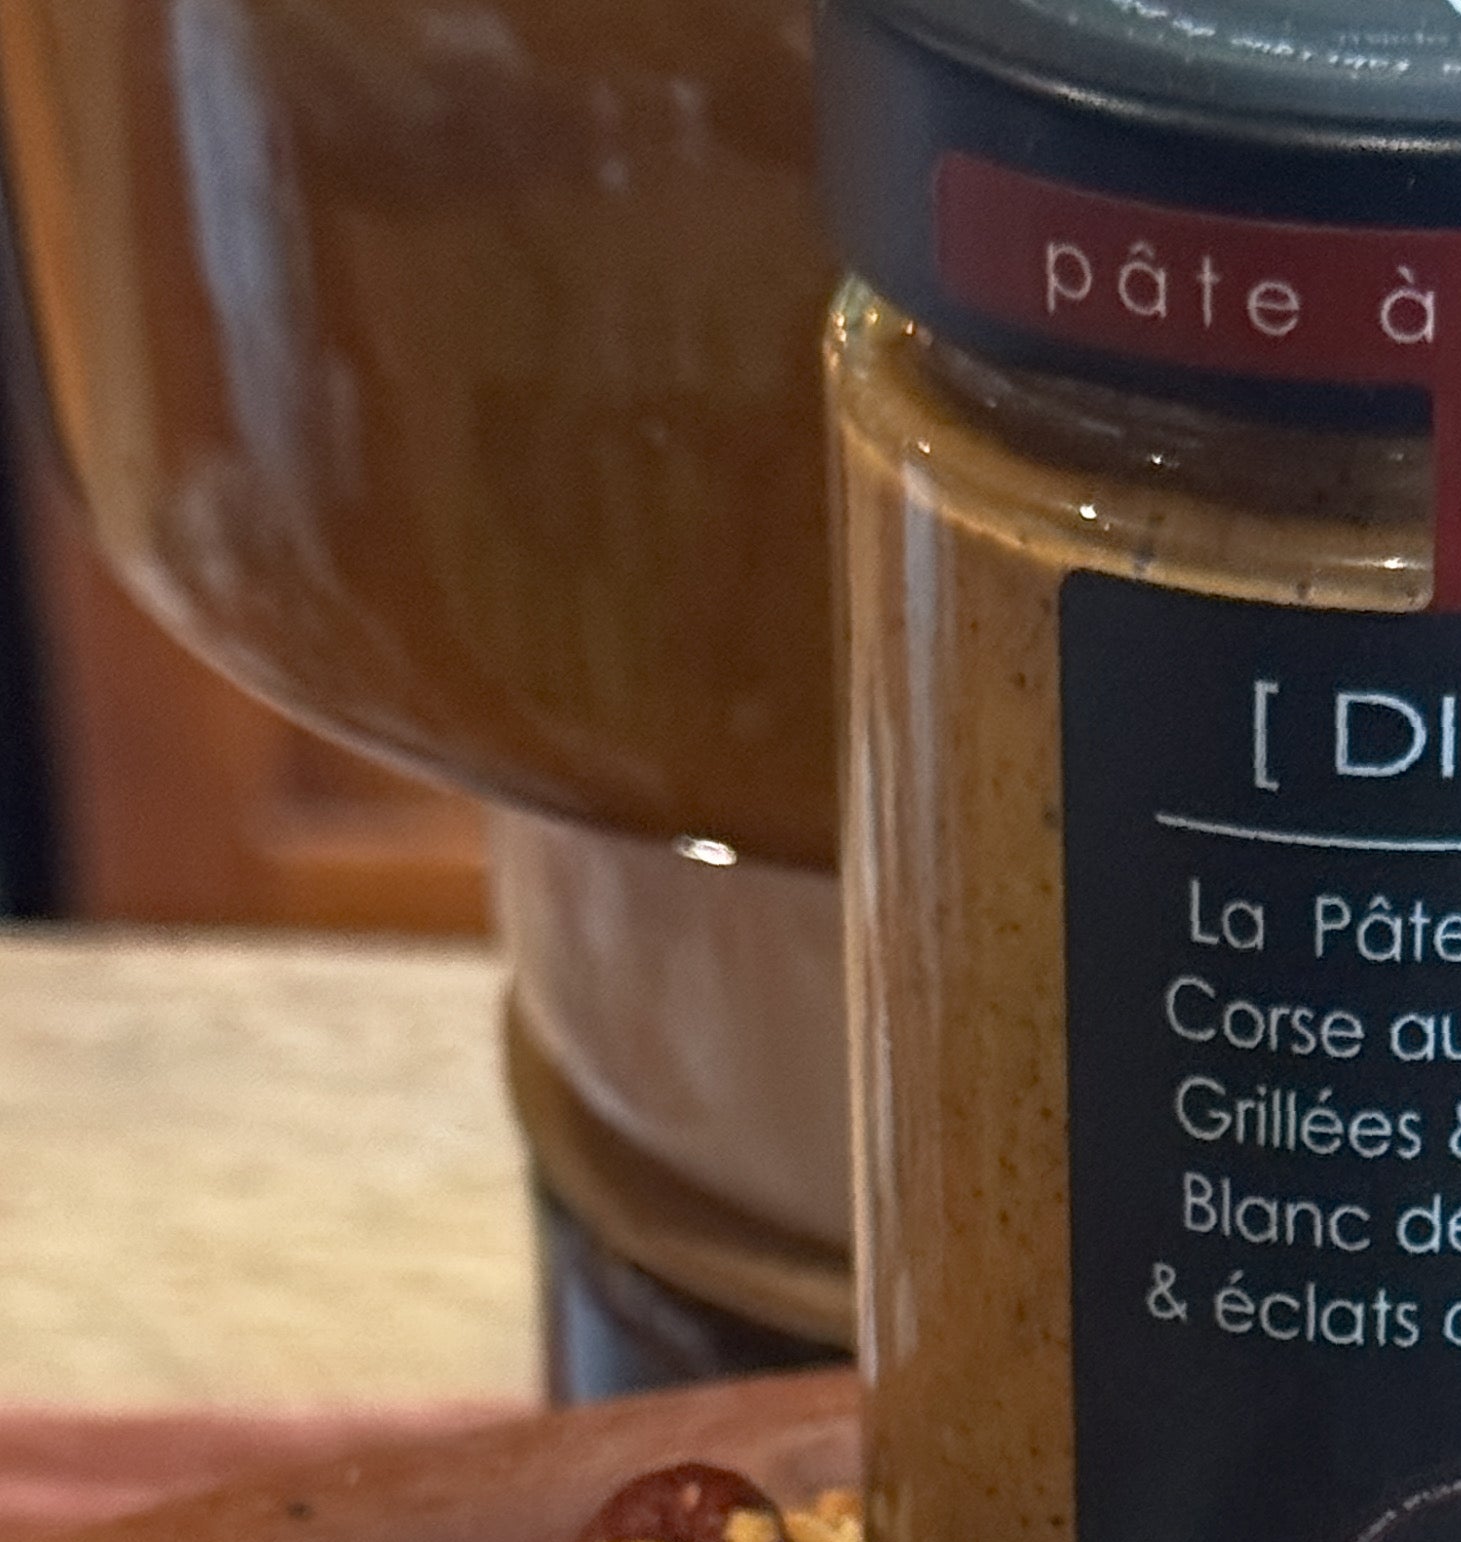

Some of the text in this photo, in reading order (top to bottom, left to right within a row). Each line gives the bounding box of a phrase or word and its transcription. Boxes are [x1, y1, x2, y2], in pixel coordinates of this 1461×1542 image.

[1045, 240, 1301, 337] pâte
[1379, 265, 1435, 344] à
[1335, 691, 1456, 778] DI
[1189, 879, 1265, 951] La
[1165, 976, 1366, 1059] Corse
[1175, 1076, 1422, 1160] Grillées
[1183, 1171, 1371, 1252] Blanc
[1145, 1262, 1188, 1321] &
[1214, 1269, 1420, 1348] éclats
